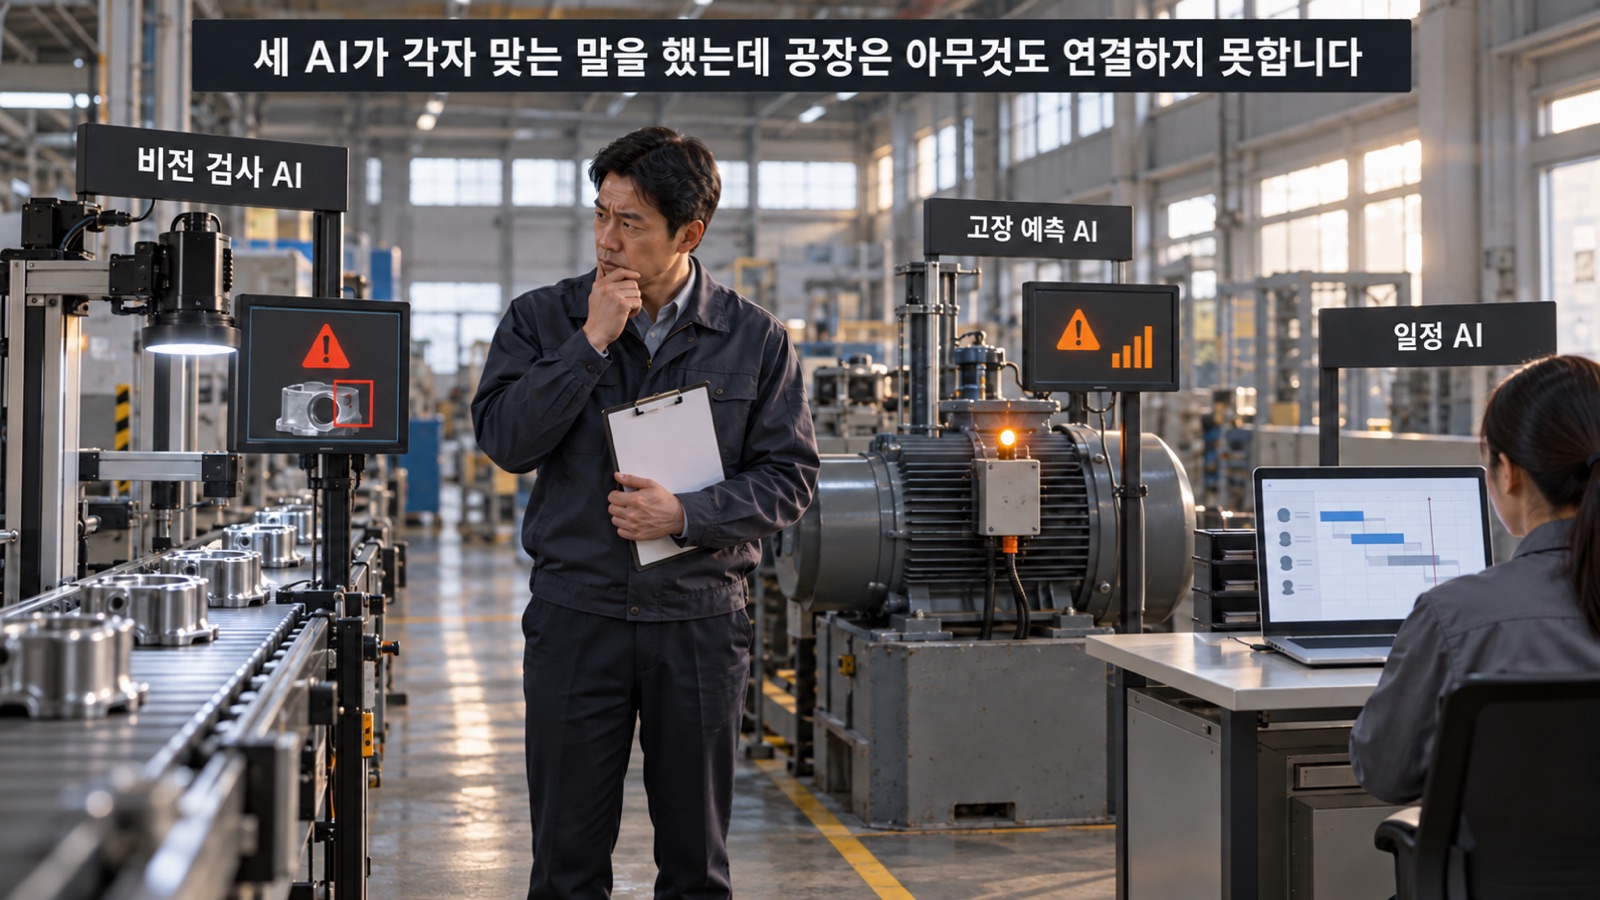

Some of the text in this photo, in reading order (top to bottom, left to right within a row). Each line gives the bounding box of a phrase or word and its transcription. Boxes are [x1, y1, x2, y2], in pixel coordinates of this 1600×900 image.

[138, 146, 302, 189] 비전 검사 AI
[967, 214, 1098, 244] 고장 예측 AI
[1393, 321, 1482, 351] 일정 AI
